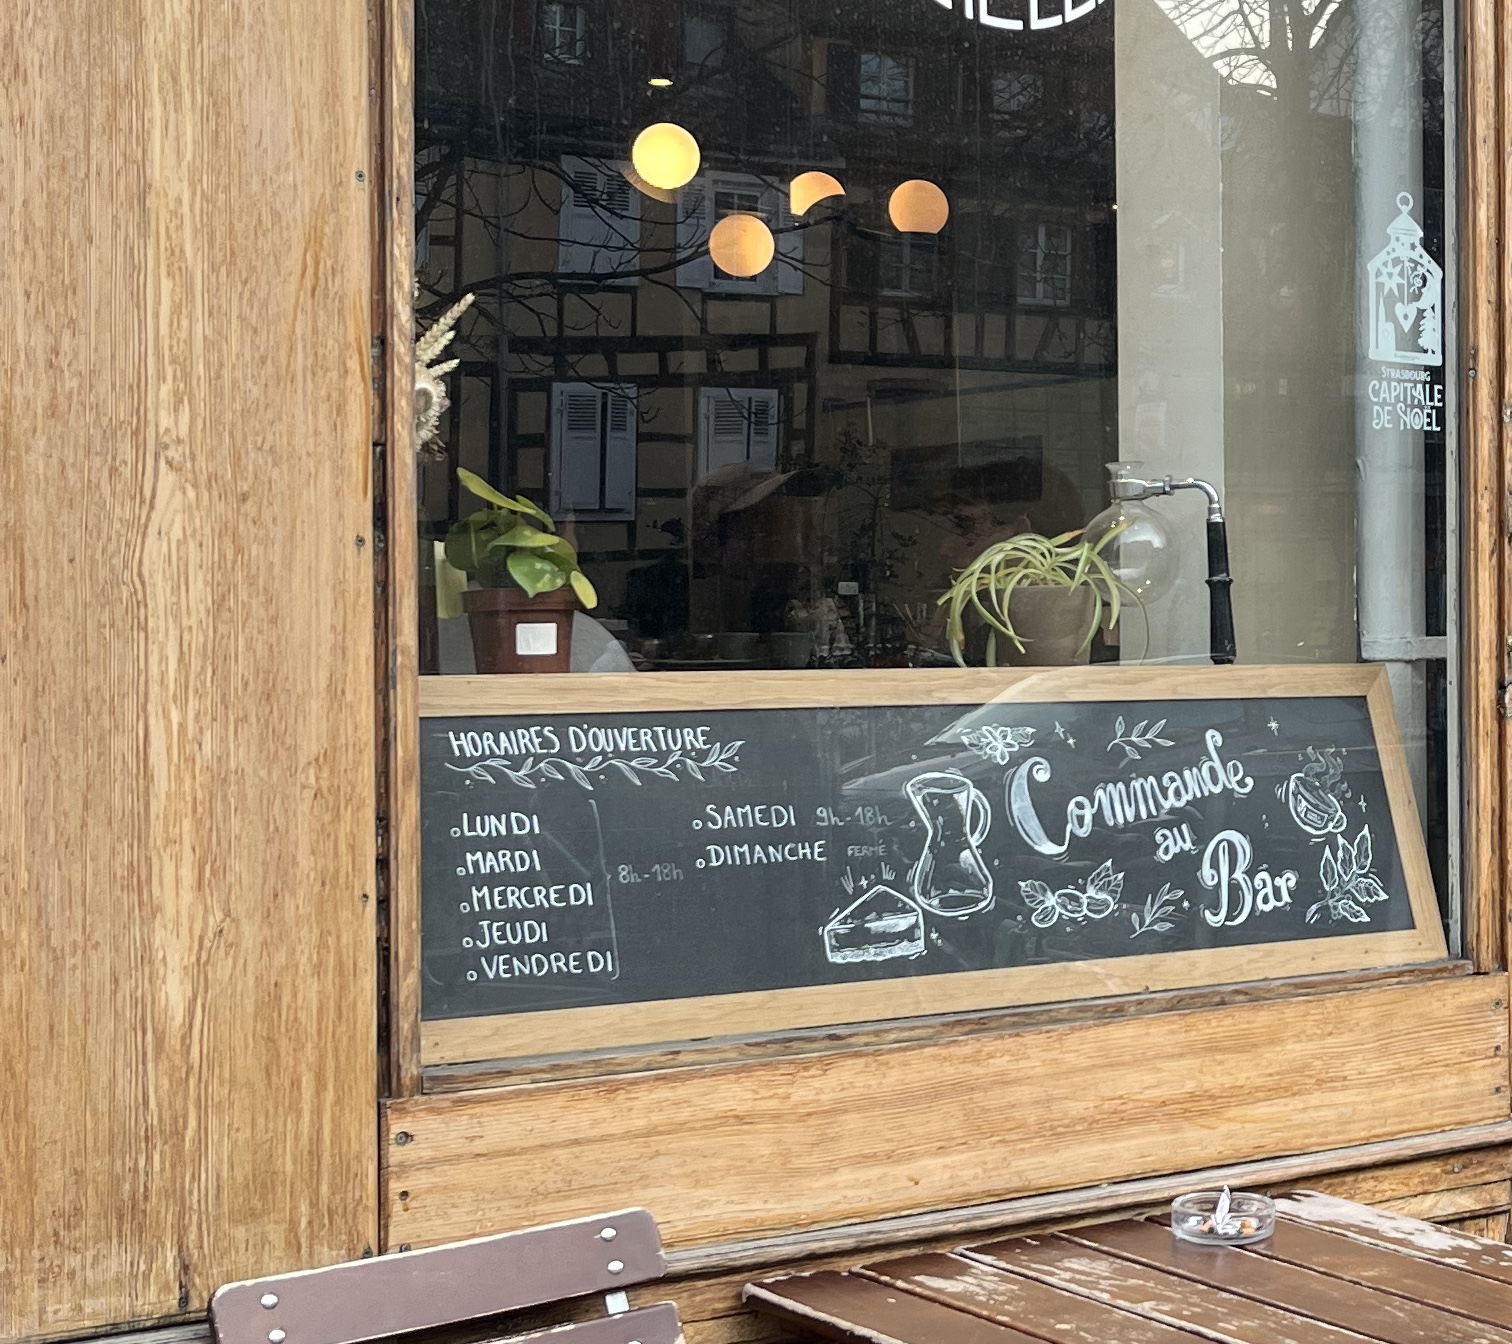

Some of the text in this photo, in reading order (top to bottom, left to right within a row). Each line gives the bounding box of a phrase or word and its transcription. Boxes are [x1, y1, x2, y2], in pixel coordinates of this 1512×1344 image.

[1368, 380, 1443, 407] CAPITALE
[1372, 402, 1441, 431] DE NOËL
[448, 723, 712, 757] HORAIRES D'OUVERTURE
[1006, 727, 1254, 860] Commande
[462, 812, 541, 837] LUNDI
[705, 804, 797, 830] SAMEDI
[705, 840, 888, 867] DIMANCHE FERMÉ
[1155, 821, 1192, 863] au
[466, 849, 541, 875] MARDI
[1202, 828, 1298, 929] Bar
[471, 883, 593, 912] MERCREDI
[476, 920, 549, 949] JEUDI
[480, 951, 614, 980] VENDREDI
